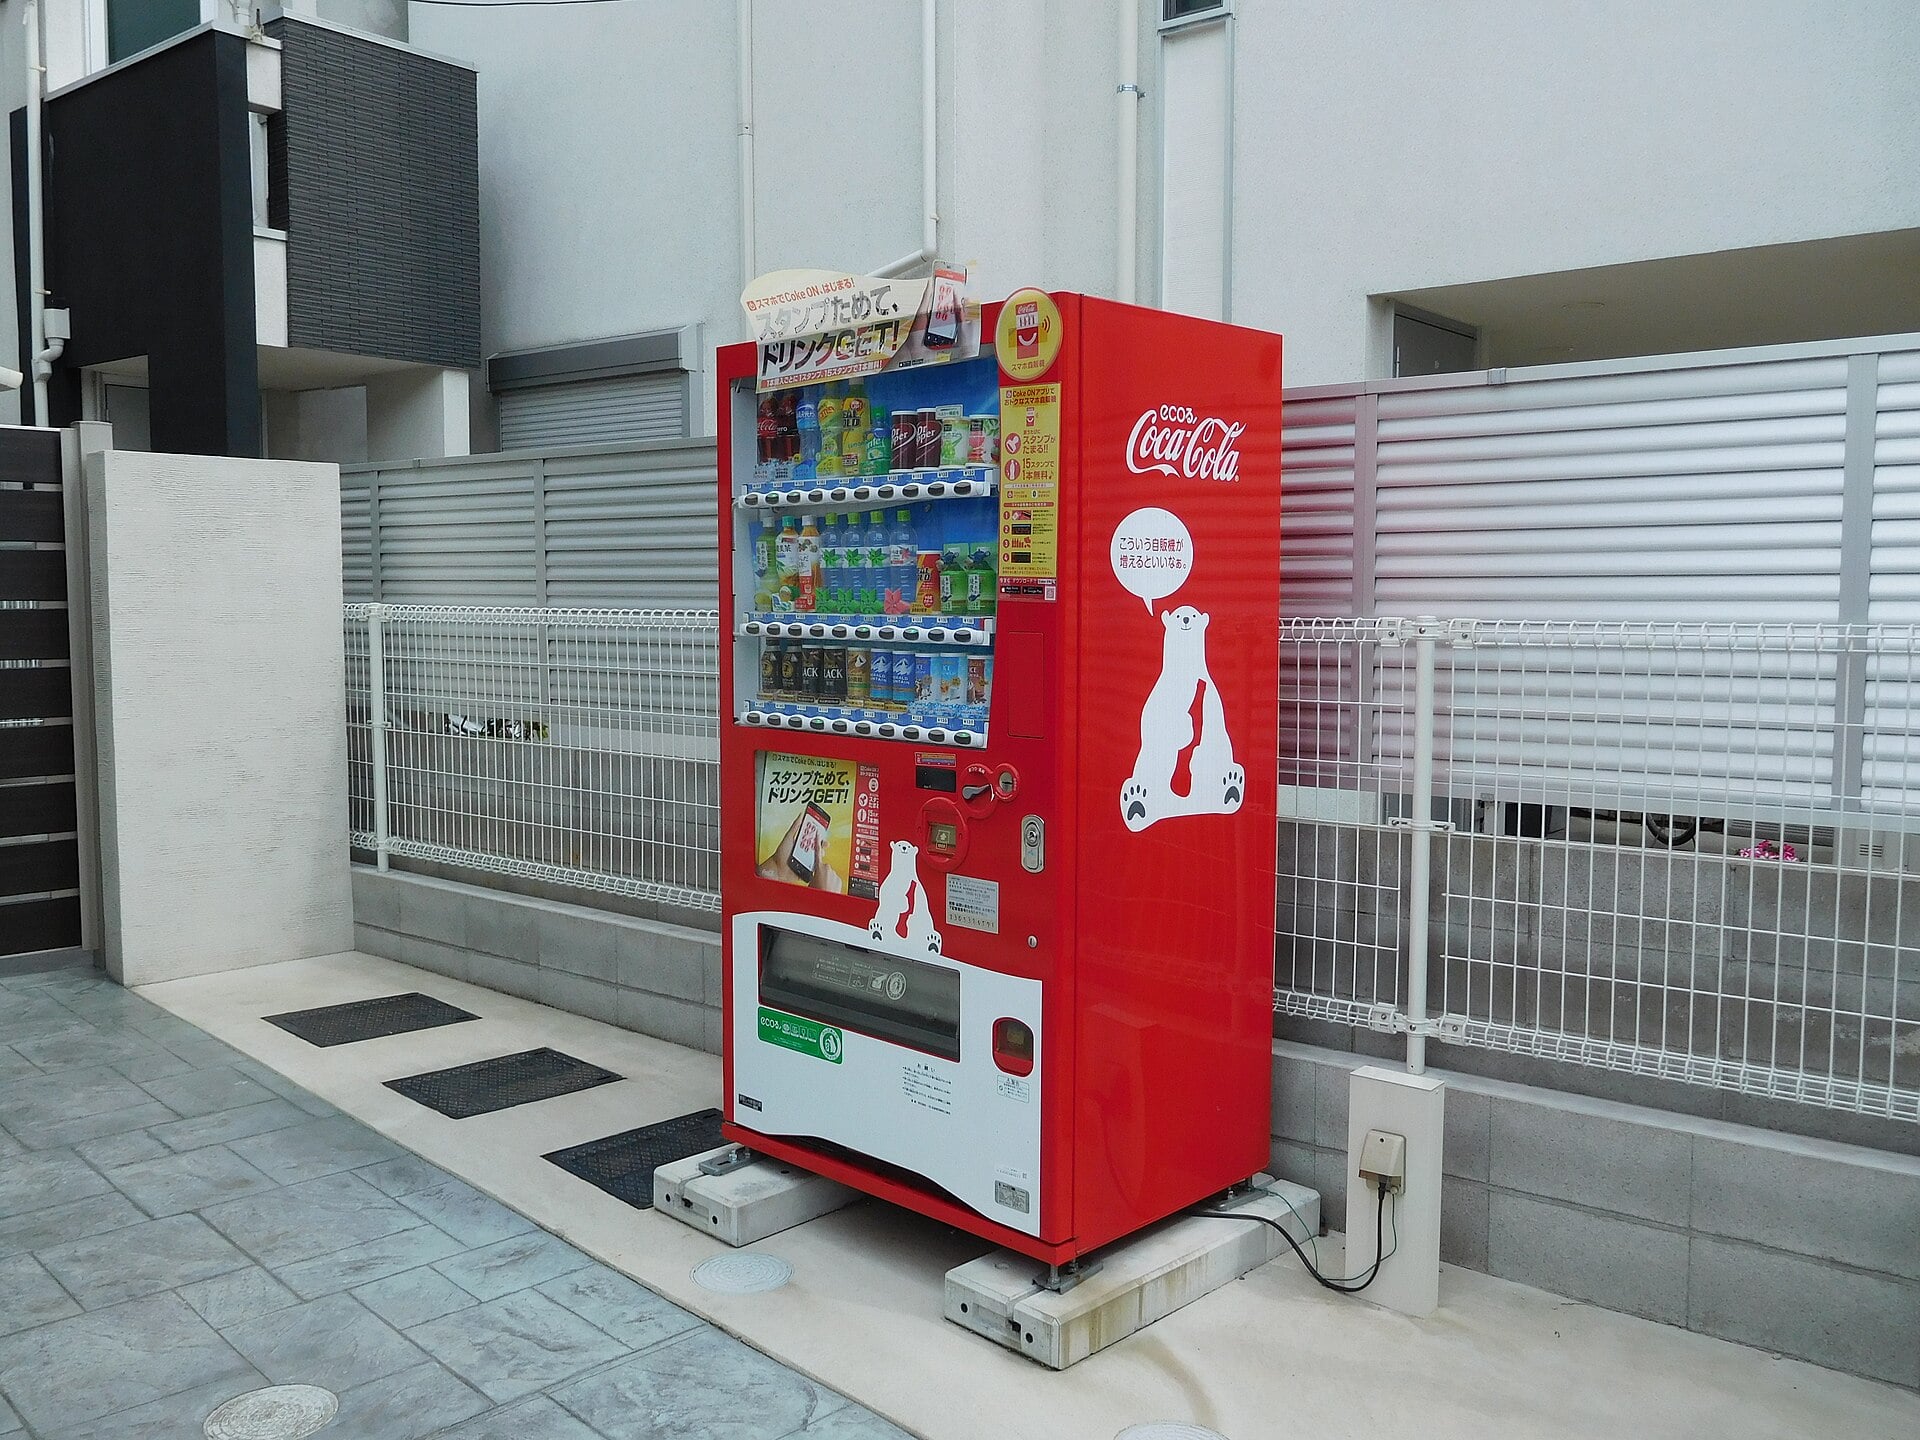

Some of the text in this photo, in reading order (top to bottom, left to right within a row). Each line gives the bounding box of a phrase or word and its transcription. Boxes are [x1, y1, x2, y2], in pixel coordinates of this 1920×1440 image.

[762, 319, 900, 376] ドリンクGET!
[1126, 409, 1247, 482] Coca-Cola
[1119, 537, 1184, 552] こういう自販機が
[1119, 554, 1187, 569] 増えるといいなぁ。
[769, 769, 850, 786] スタンプためて、
[767, 787, 849, 804] ドリンクGET!
